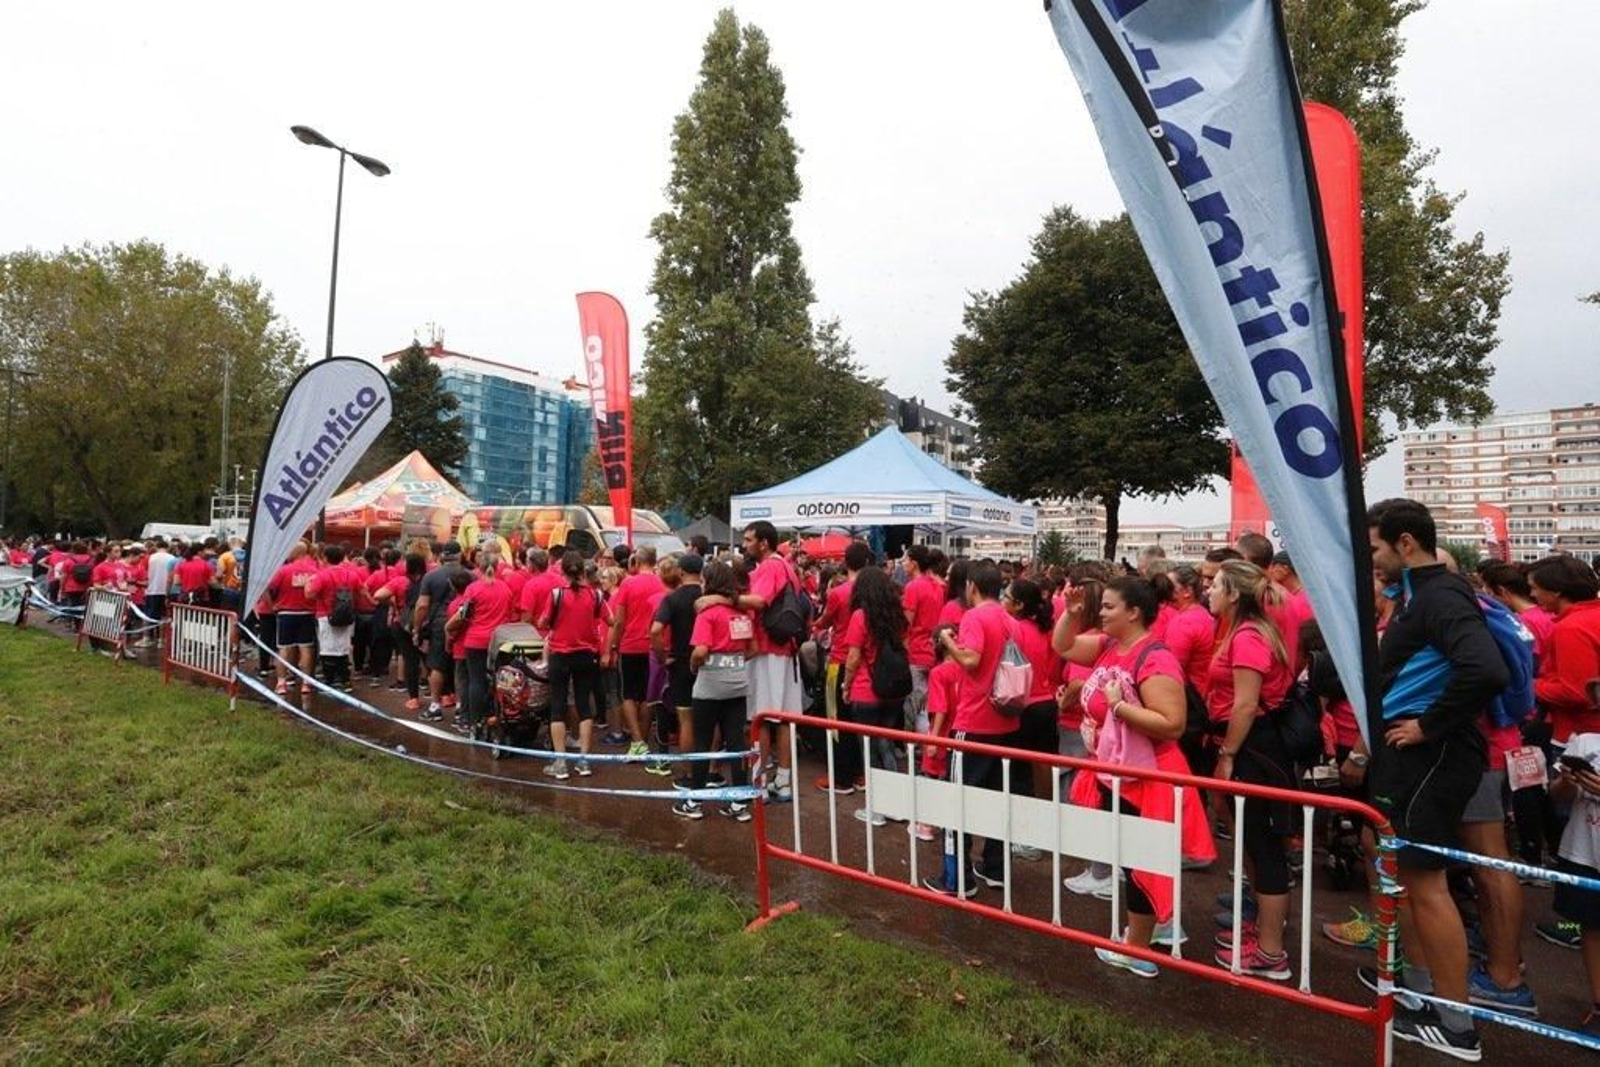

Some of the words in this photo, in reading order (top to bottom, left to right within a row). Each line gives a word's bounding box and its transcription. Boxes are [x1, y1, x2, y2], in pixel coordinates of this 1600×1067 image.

[1102, 0, 1343, 479] lántico
[263, 387, 377, 525] Atlántico
[797, 502, 861, 517] aptonia
